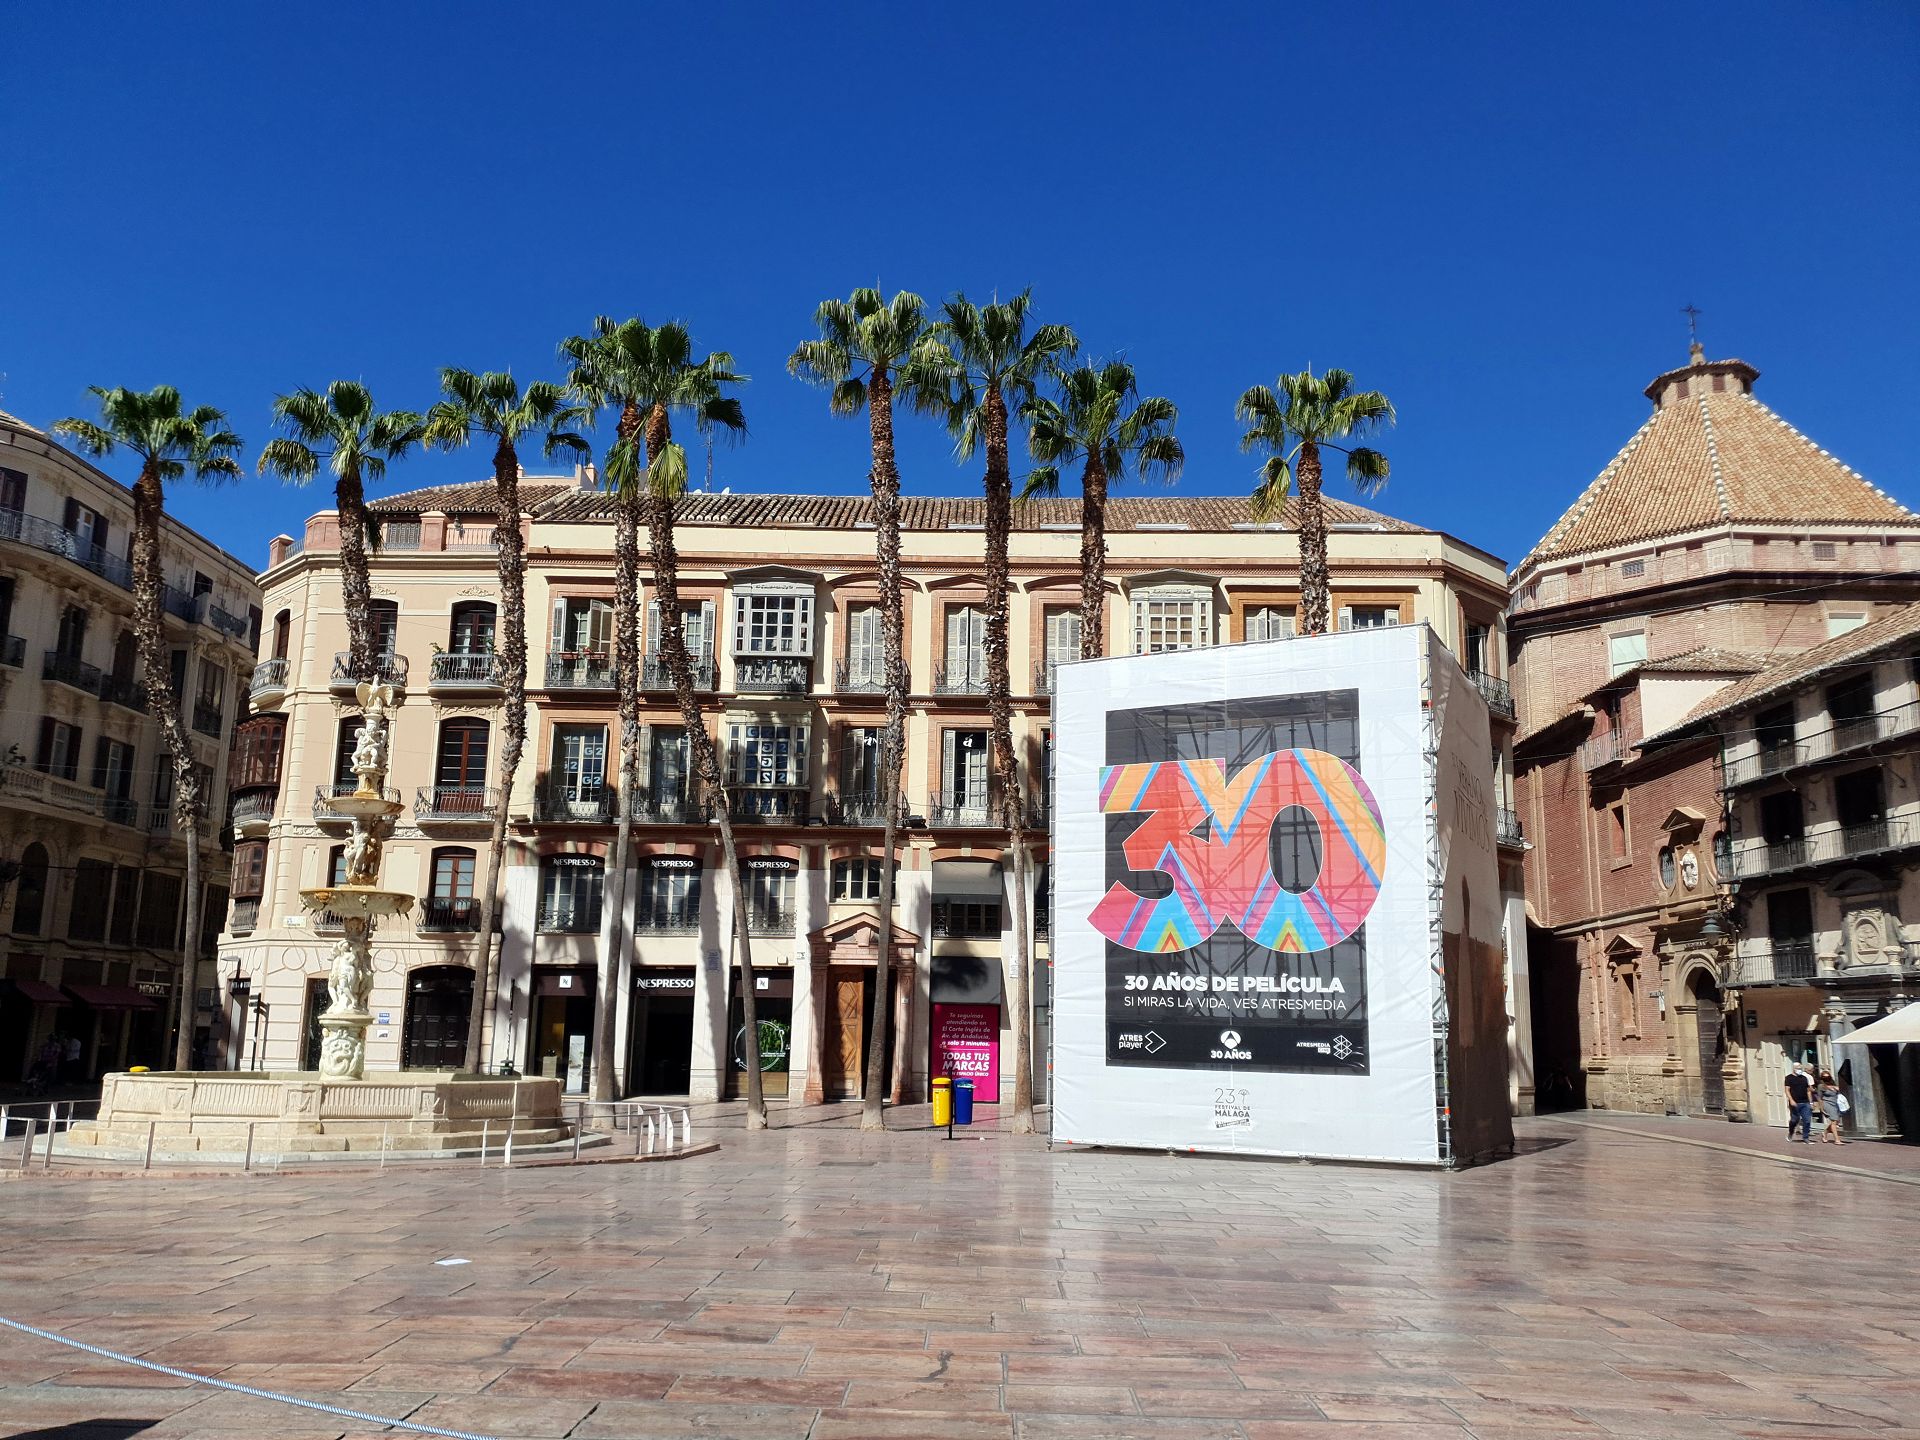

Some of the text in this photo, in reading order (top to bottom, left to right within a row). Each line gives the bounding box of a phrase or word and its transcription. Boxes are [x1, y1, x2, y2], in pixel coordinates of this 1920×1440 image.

[1087, 748, 1386, 953] 30
[553, 858, 596, 867] NESPRESSO
[651, 860, 694, 868] NESPRESSO
[748, 861, 790, 869] NESPRESSO
[637, 977, 695, 989] NESPRESSO
[1124, 971, 1346, 993] 30 AÑOS DE PELÍCULA
[139, 984, 165, 995] MENTA
[1124, 996, 1347, 1011] SI MIRAS LA VIDA, VES ATRESMEDIA
[1118, 1041, 1143, 1050] player
[943, 1052, 990, 1061] TODAS TUS
[1210, 1048, 1252, 1060] 30 AÑOS
[942, 1061, 990, 1071] MARCAS
[1214, 1087, 1236, 1104] 23
